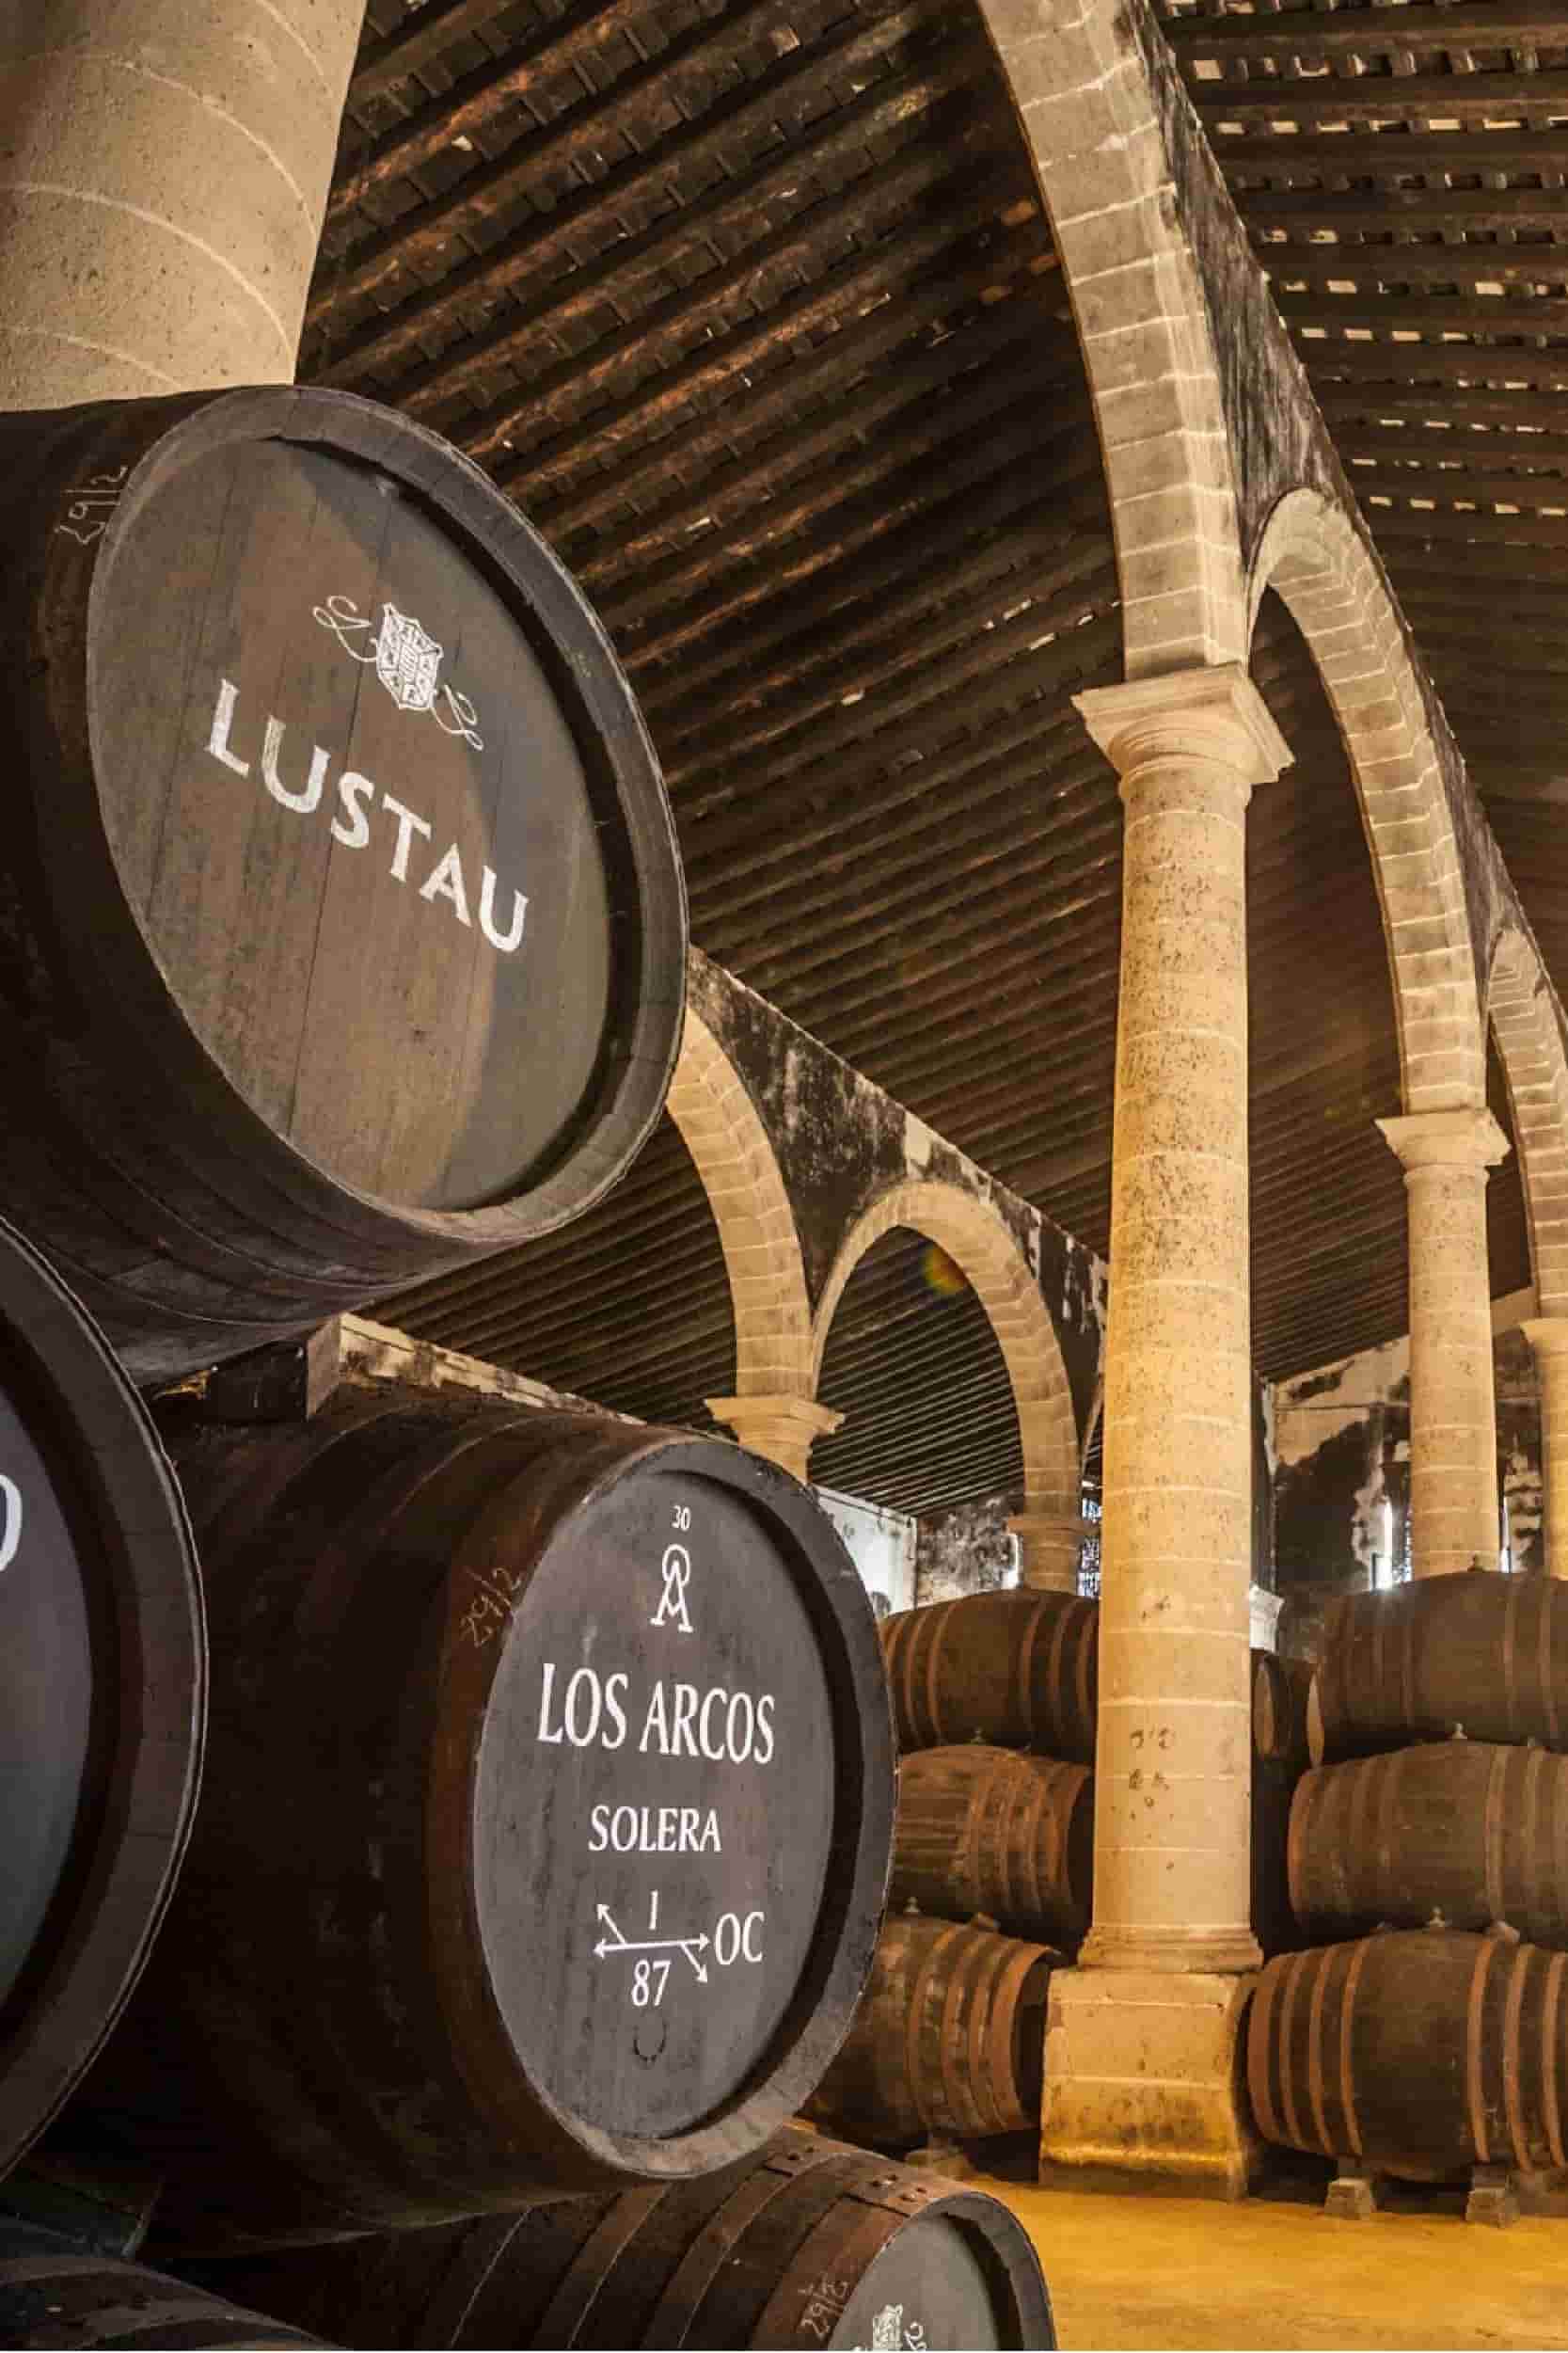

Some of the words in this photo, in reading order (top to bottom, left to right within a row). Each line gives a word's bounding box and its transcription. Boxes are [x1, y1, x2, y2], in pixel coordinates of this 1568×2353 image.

[204, 677, 530, 953] LUSTAU
[669, 1503, 692, 1532] 30
[536, 1662, 628, 1749] LOS
[639, 1679, 775, 1765] ARCOS
[588, 1804, 722, 1853] SOLERA
[713, 1910, 765, 1966] OC
[630, 1958, 672, 2008] 87
